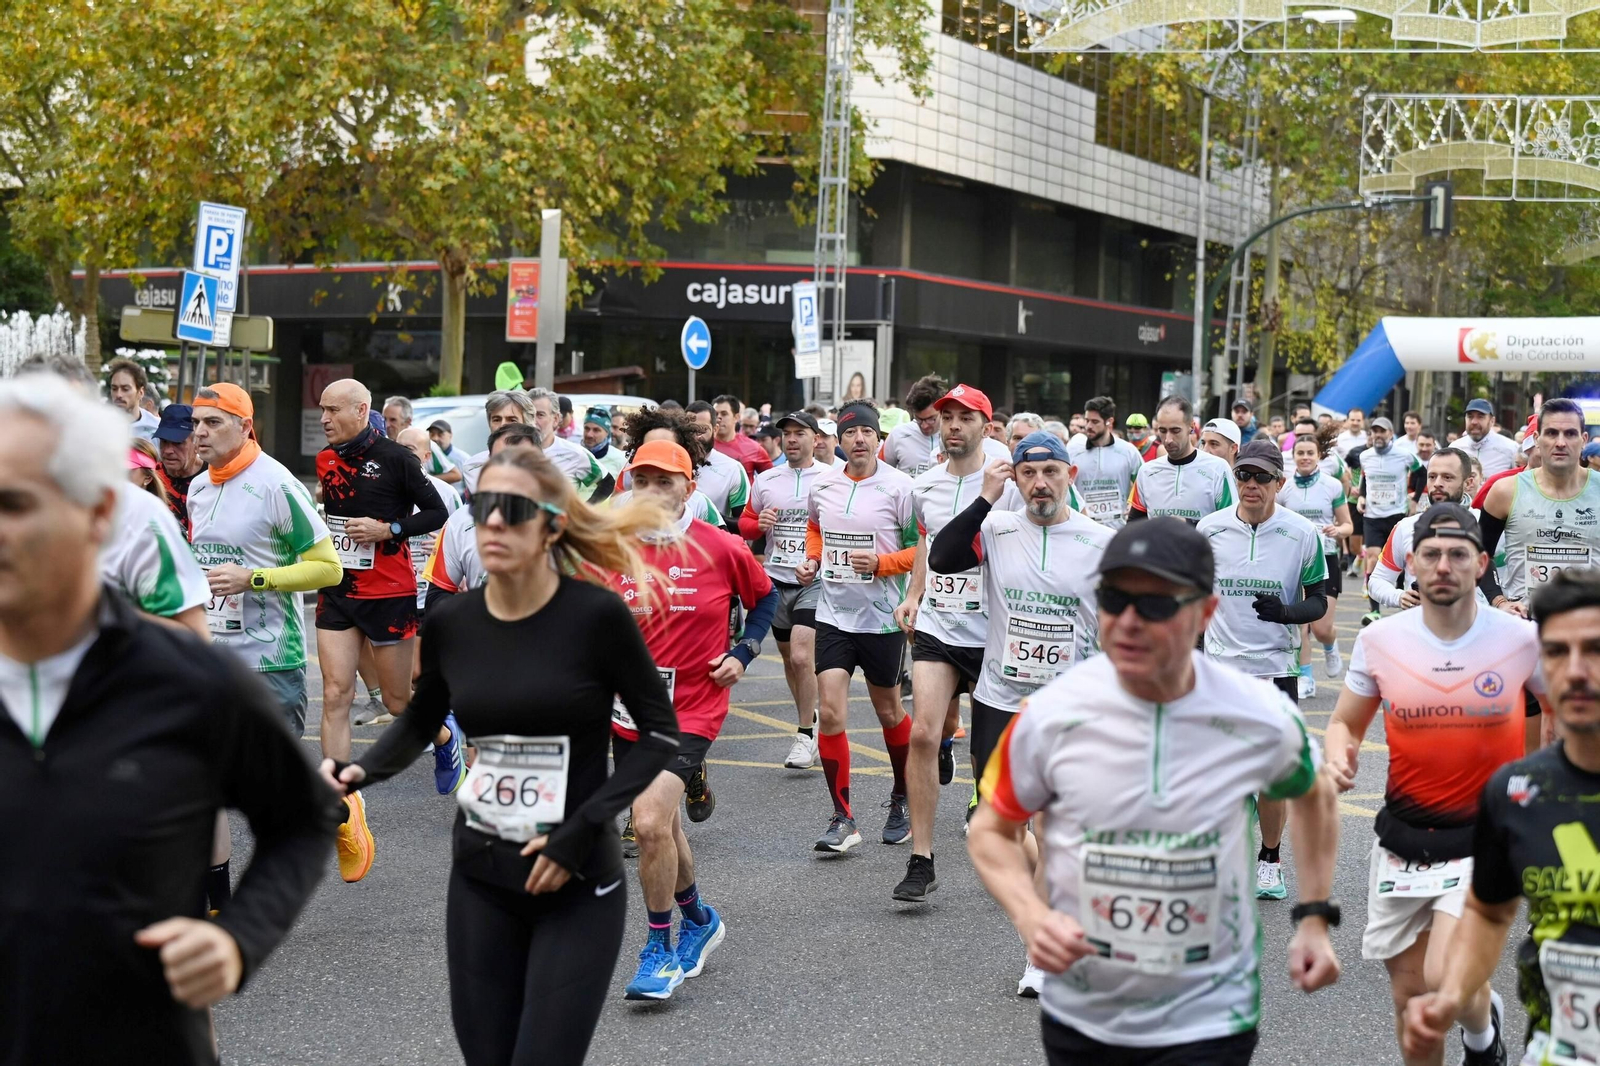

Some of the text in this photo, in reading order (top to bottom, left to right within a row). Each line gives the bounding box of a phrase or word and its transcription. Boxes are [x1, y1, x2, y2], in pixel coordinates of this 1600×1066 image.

[208, 229, 229, 266] P
[135, 283, 176, 309] cajasu
[687, 277, 792, 309] cajasur
[1507, 335, 1584, 348] Diputación
[1506, 349, 1585, 361] de Córdoba
[1093, 503, 1113, 514] 201
[1167, 508, 1202, 517] SUBIDA
[1275, 527, 1288, 537] SIG
[780, 539, 805, 554] 454
[1074, 534, 1090, 545] SIG
[201, 543, 245, 556] SUBIDA
[935, 575, 968, 595] 537
[1217, 578, 1283, 590] XII SUBIDA
[1004, 588, 1081, 607] XII SUBIDA
[1015, 604, 1034, 613] LAS
[1035, 606, 1078, 617] ERMITAS
[1016, 641, 1060, 665] 546
[477, 773, 540, 807] 266
[1109, 895, 1191, 935] 678
